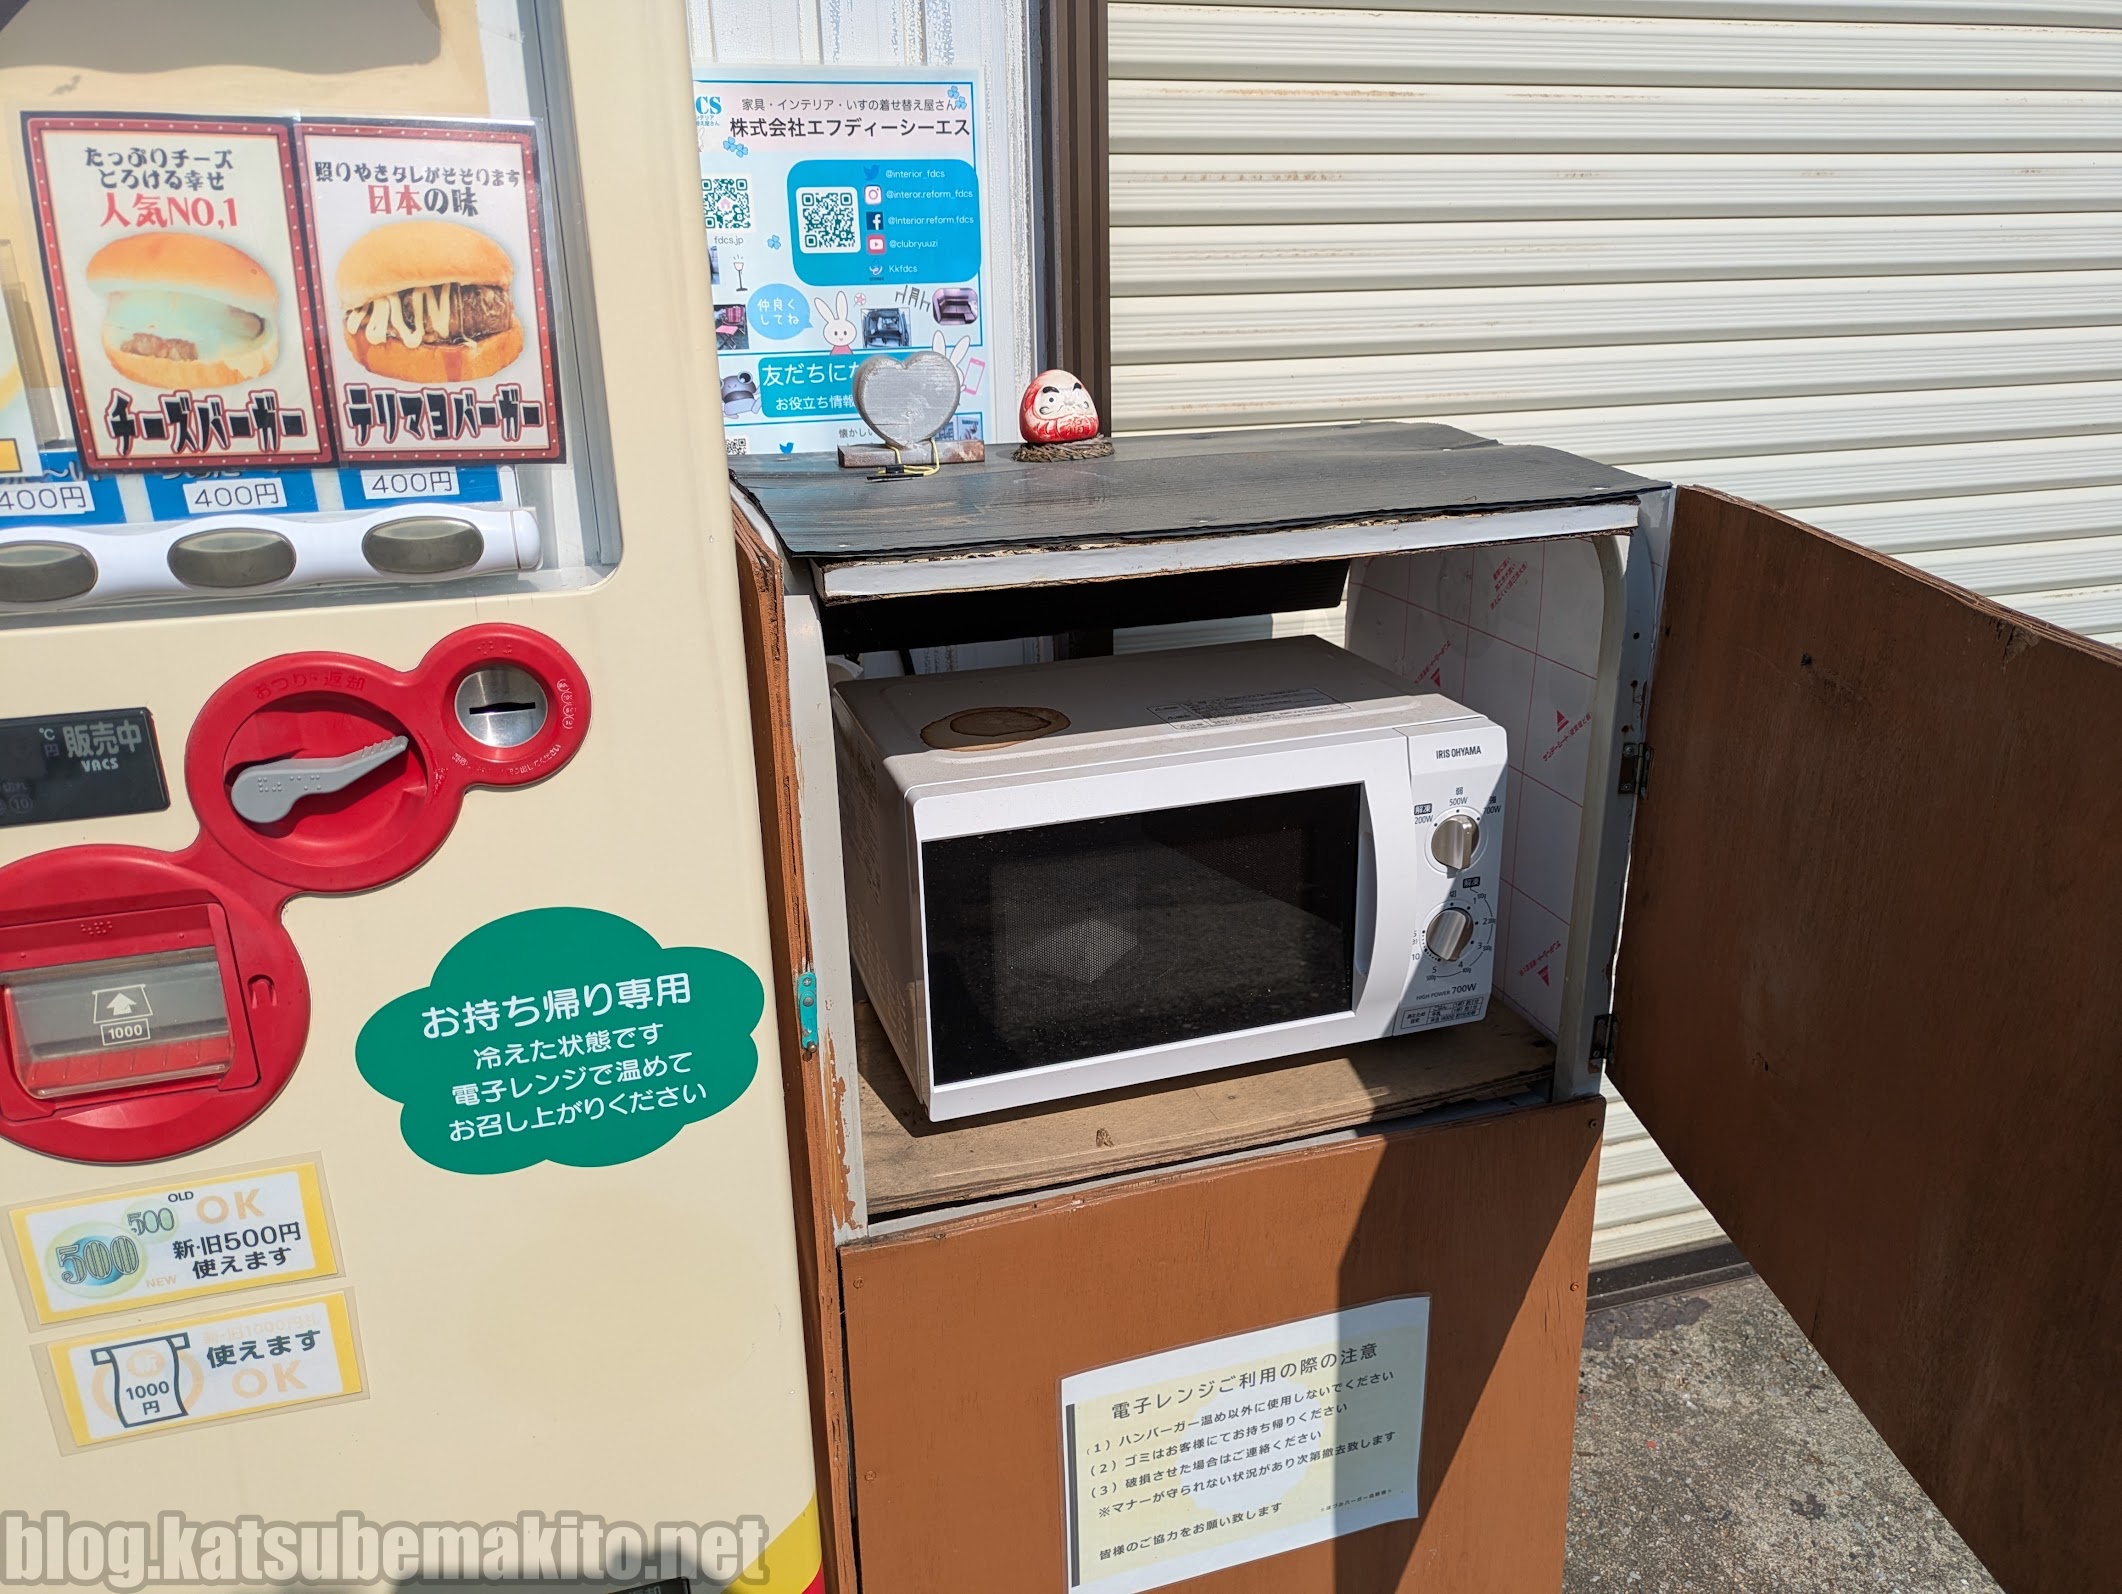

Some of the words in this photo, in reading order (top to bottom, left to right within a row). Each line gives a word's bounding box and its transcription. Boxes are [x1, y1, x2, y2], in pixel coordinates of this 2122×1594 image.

[742, 98, 957, 111] 家具・インテリア・いすの着せ替え屋さん
[730, 117, 970, 138] 株式会社エフディーシーエス
[84, 146, 234, 169] たっぷりチーズ
[98, 169, 225, 192] とろける幸せ
[315, 160, 521, 188] 照りやきタレがそそります
[885, 169, 945, 179] @interior_fdcs
[368, 185, 479, 217] 日本の味
[714, 235, 744, 247] fdcs.jp
[758, 297, 796, 311] 仲良く
[761, 313, 800, 326] してね
[105, 387, 309, 458] チーズバーガー
[344, 382, 544, 445] テリマヨバーガー
[371, 470, 455, 495] 400円
[0, 486, 87, 511] 400円
[194, 483, 279, 508] 400円
[62, 720, 143, 759] 販売中
[81, 757, 119, 773] VACS
[1436, 749, 1450, 760] IRIS
[1451, 745, 1482, 758] OHYAMA
[1449, 796, 1468, 806] 500W
[1414, 815, 1434, 825] 200W
[1411, 953, 1420, 961] 10
[1432, 966, 1437, 974] 5
[1416, 992, 1430, 1001] HIGH
[1430, 990, 1451, 999] POWER
[1451, 982, 1478, 995] 700W
[421, 972, 692, 1039] お持ち帰り専用
[107, 1022, 144, 1041] 1000
[473, 1022, 664, 1071] 冷えた状態です
[451, 1052, 694, 1107] 電子レンジで温めて
[448, 1083, 707, 1143] お召し上がりください
[167, 1190, 195, 1203] OLD
[196, 1187, 265, 1226] OK
[126, 1207, 176, 1237] 500
[55, 1235, 140, 1286] 500
[192, 1246, 293, 1280] 使えます
[145, 1274, 178, 1289] NEW
[206, 1329, 322, 1369] 使えます
[125, 1380, 171, 1402] 1000
[231, 1359, 308, 1400] OK
[1111, 1342, 1378, 1420] 電子レンジご利用の際の注意
[142, 1400, 161, 1416] 円
[1098, 1431, 1397, 1518] ※マナーが守られない状況があり次第撤去致します
[1099, 1502, 1283, 1561] 皆様のご協力をお願い致します
